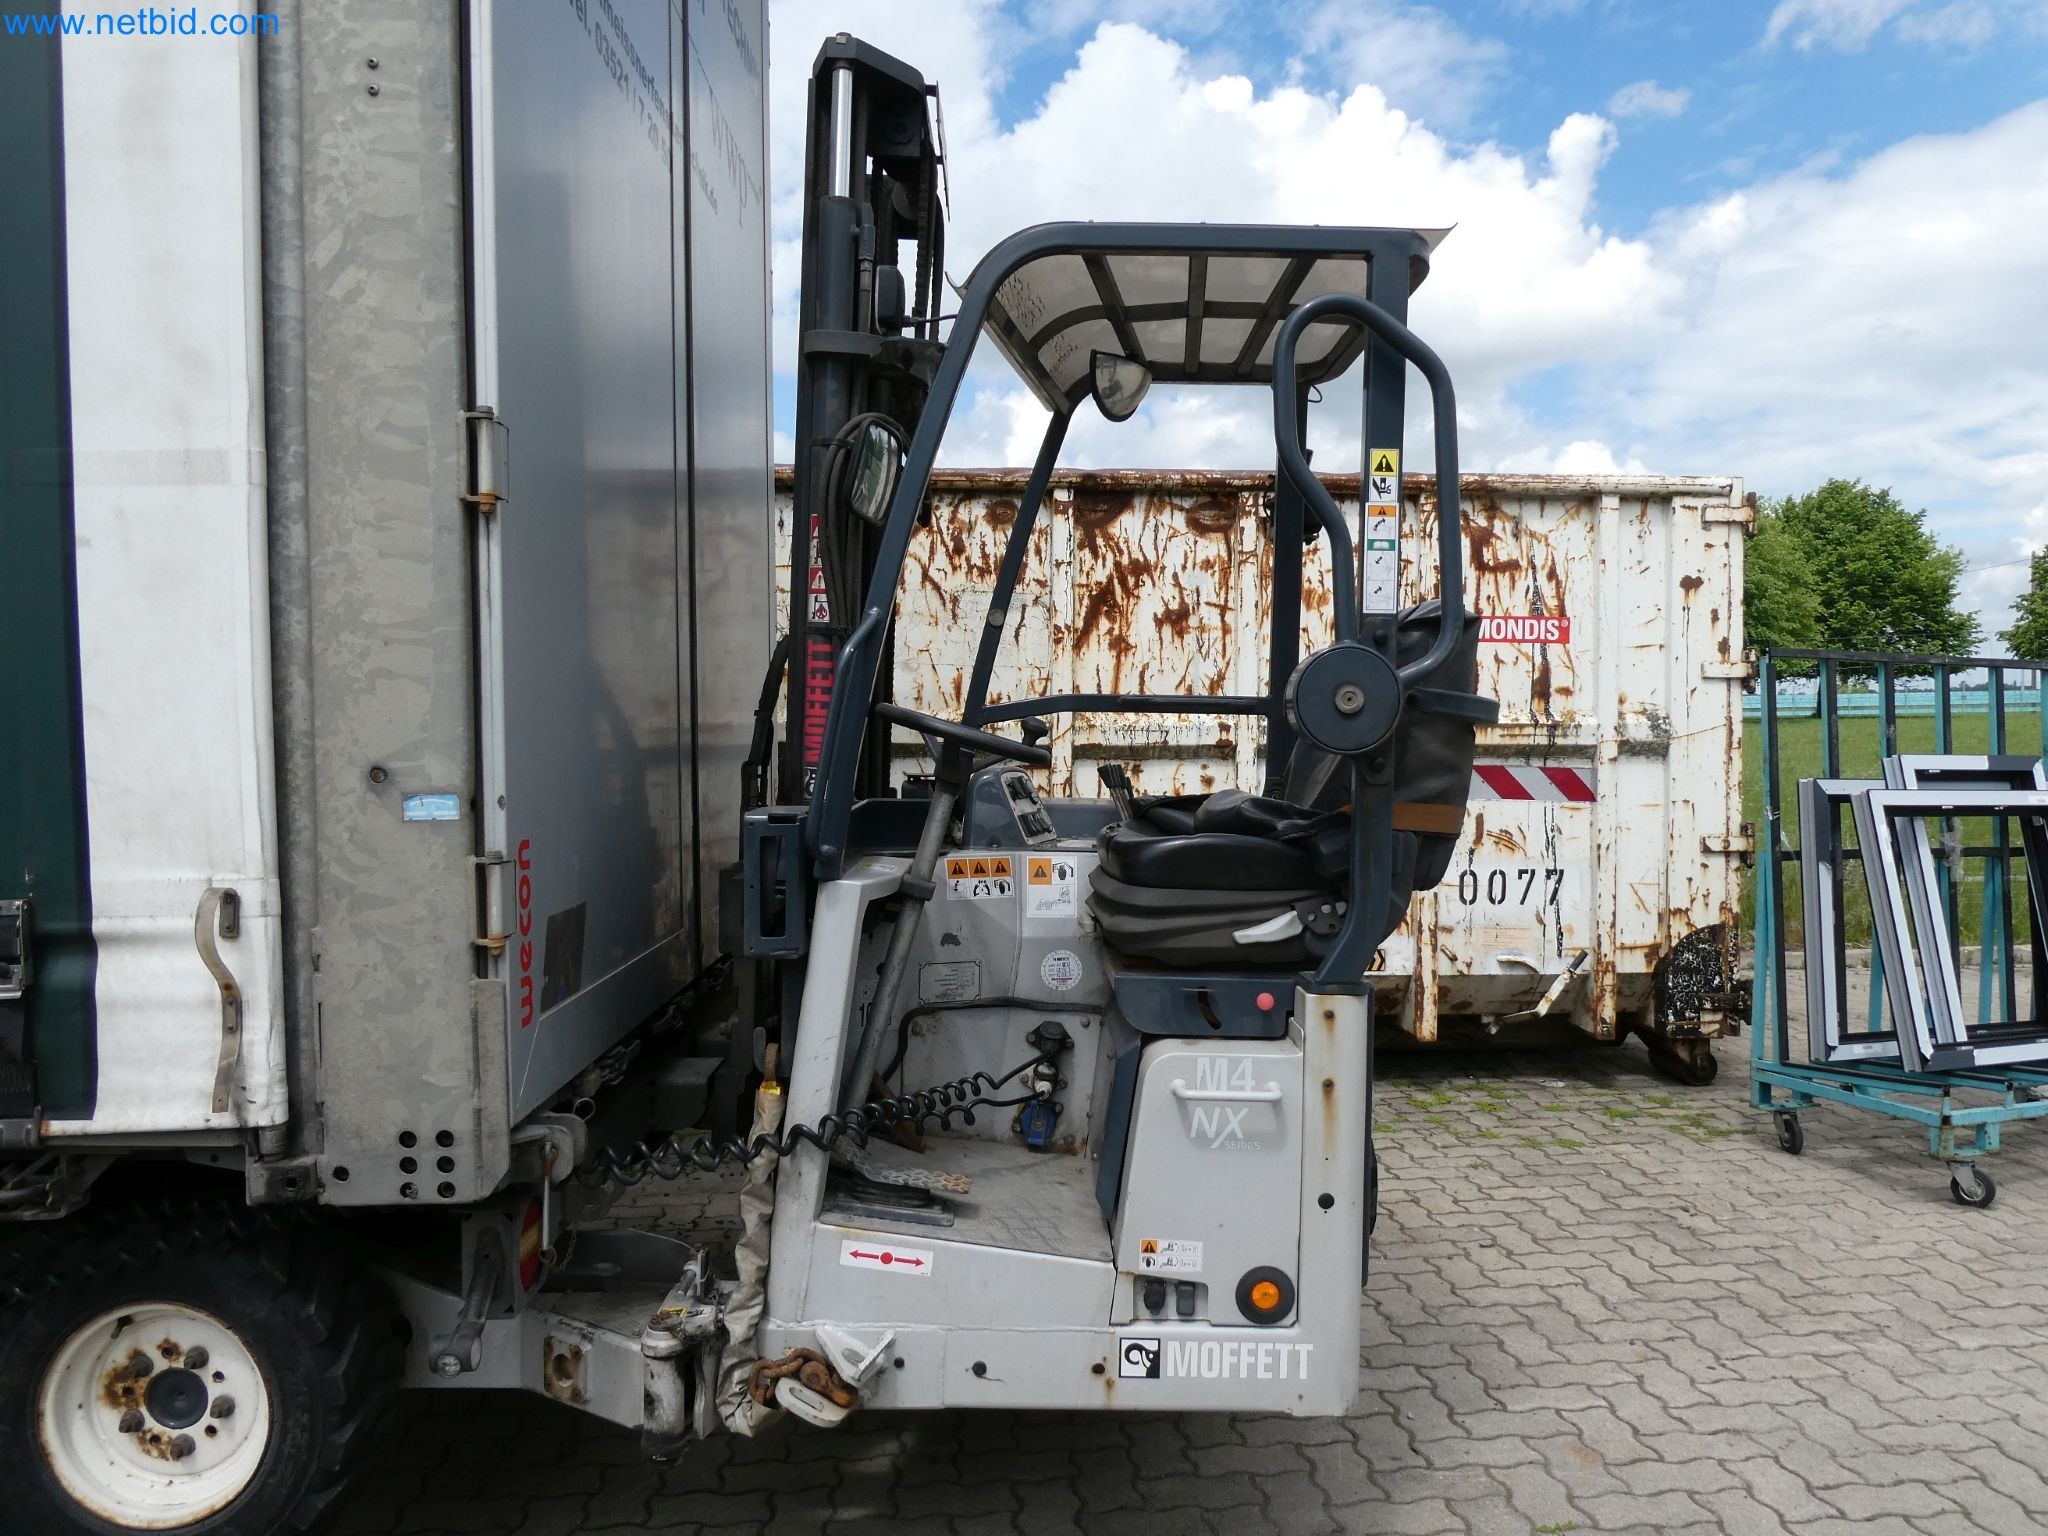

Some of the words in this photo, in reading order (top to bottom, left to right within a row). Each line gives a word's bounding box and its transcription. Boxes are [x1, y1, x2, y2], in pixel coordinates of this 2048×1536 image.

[595, 21, 630, 102] 03521
[1458, 868, 1565, 906] 0077
[517, 838, 534, 1029] wecon
[1196, 1057, 1256, 1092] M4
[1189, 1106, 1250, 1149] NX
[1223, 1140, 1261, 1151] SERIES
[1166, 1340, 1314, 1380] MOFFETT
